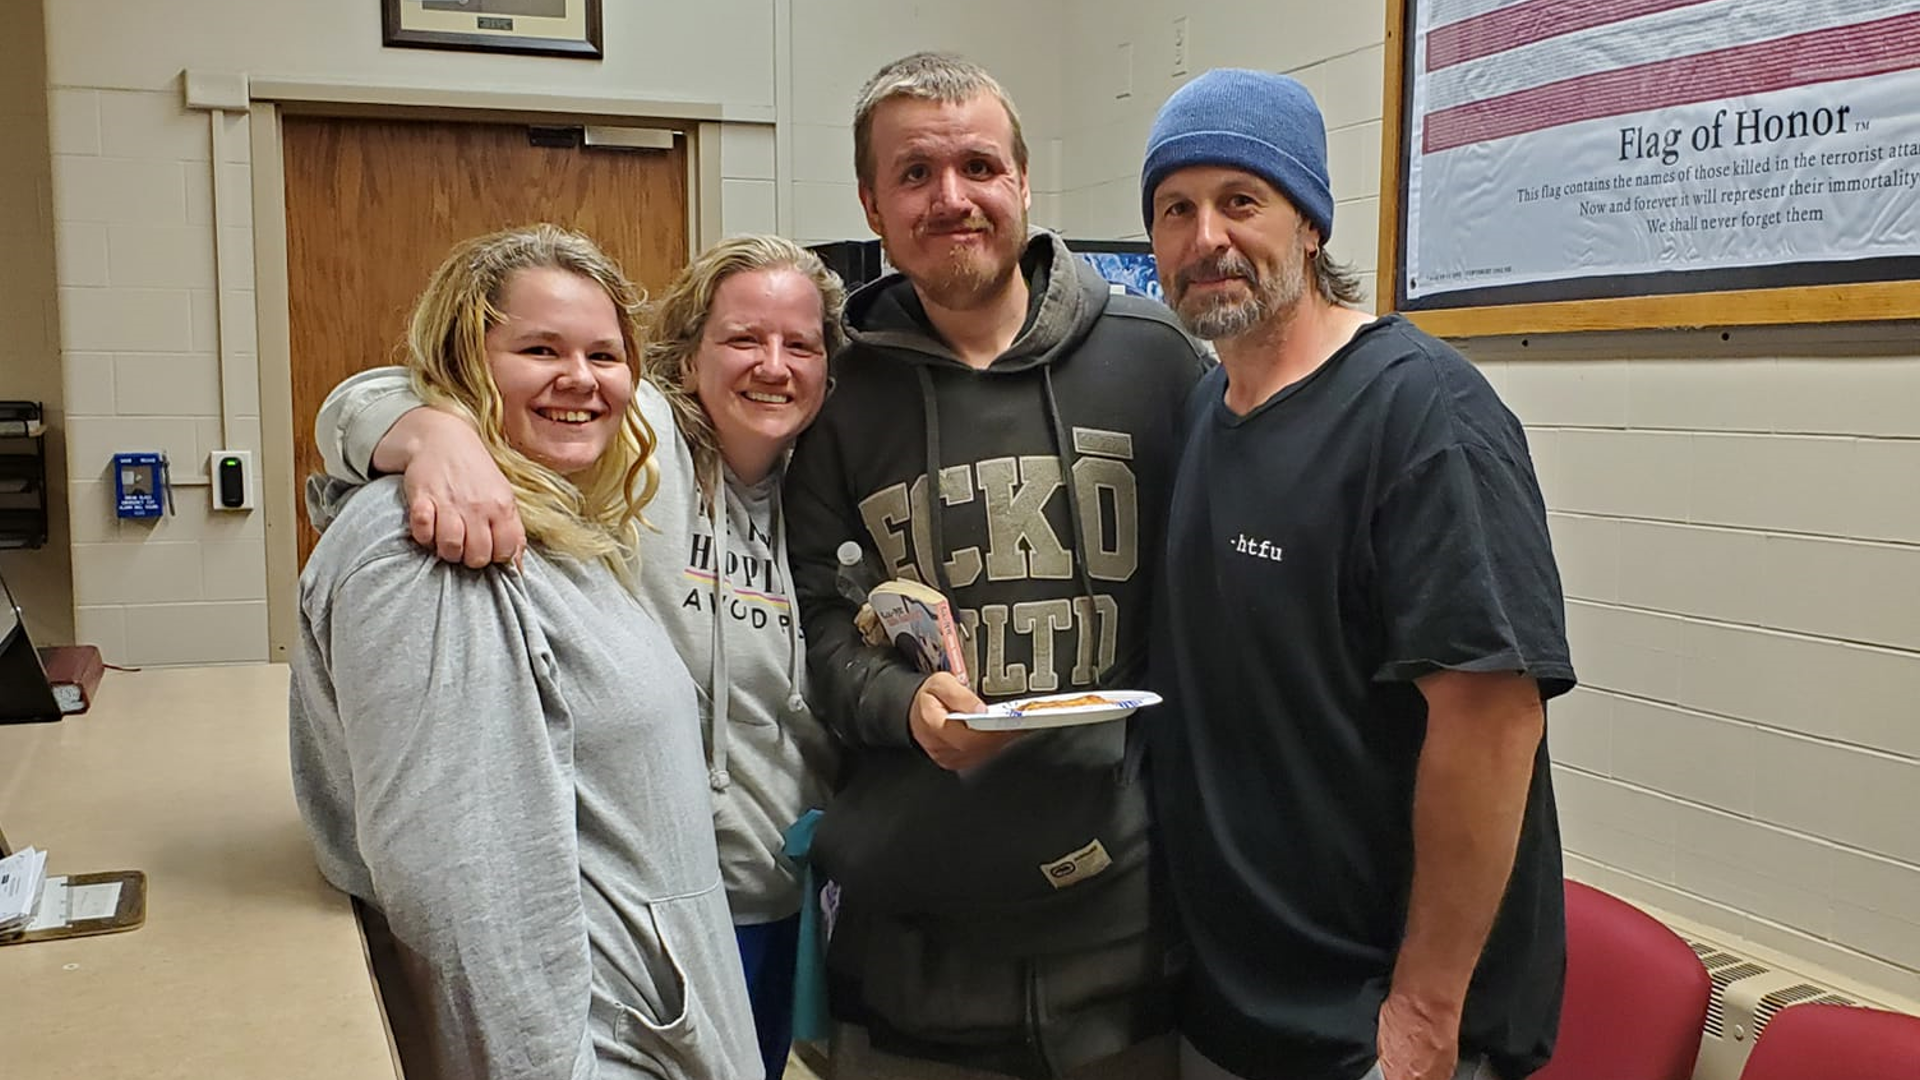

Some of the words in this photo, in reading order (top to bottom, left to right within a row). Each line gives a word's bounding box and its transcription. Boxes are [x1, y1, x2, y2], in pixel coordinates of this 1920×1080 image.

[1618, 126, 1682, 166] Flag
[1691, 108, 1727, 151] of
[1734, 105, 1850, 147] Honor
[1516, 187, 1539, 203] This
[1541, 184, 1561, 200] flag
[1563, 177, 1611, 196] contains
[1613, 173, 1632, 189] the
[1635, 171, 1675, 187] names
[1677, 167, 1693, 183] of
[1694, 163, 1730, 181] those
[1733, 156, 1770, 176] killed
[1775, 155, 1788, 172] in
[1794, 152, 1816, 168] the
[1821, 145, 1884, 165] terrorist
[1579, 201, 1606, 217] Now
[1609, 197, 1631, 213] and
[1634, 195, 1676, 211] forever
[1681, 193, 1689, 207] it
[1692, 188, 1717, 205] will
[1720, 186, 1785, 205] represent
[1789, 180, 1824, 196] their
[1646, 218, 1666, 233] We
[1669, 215, 1698, 232] shall
[1701, 215, 1737, 232] never
[1741, 211, 1781, 230] forget
[1786, 207, 1824, 223] them
